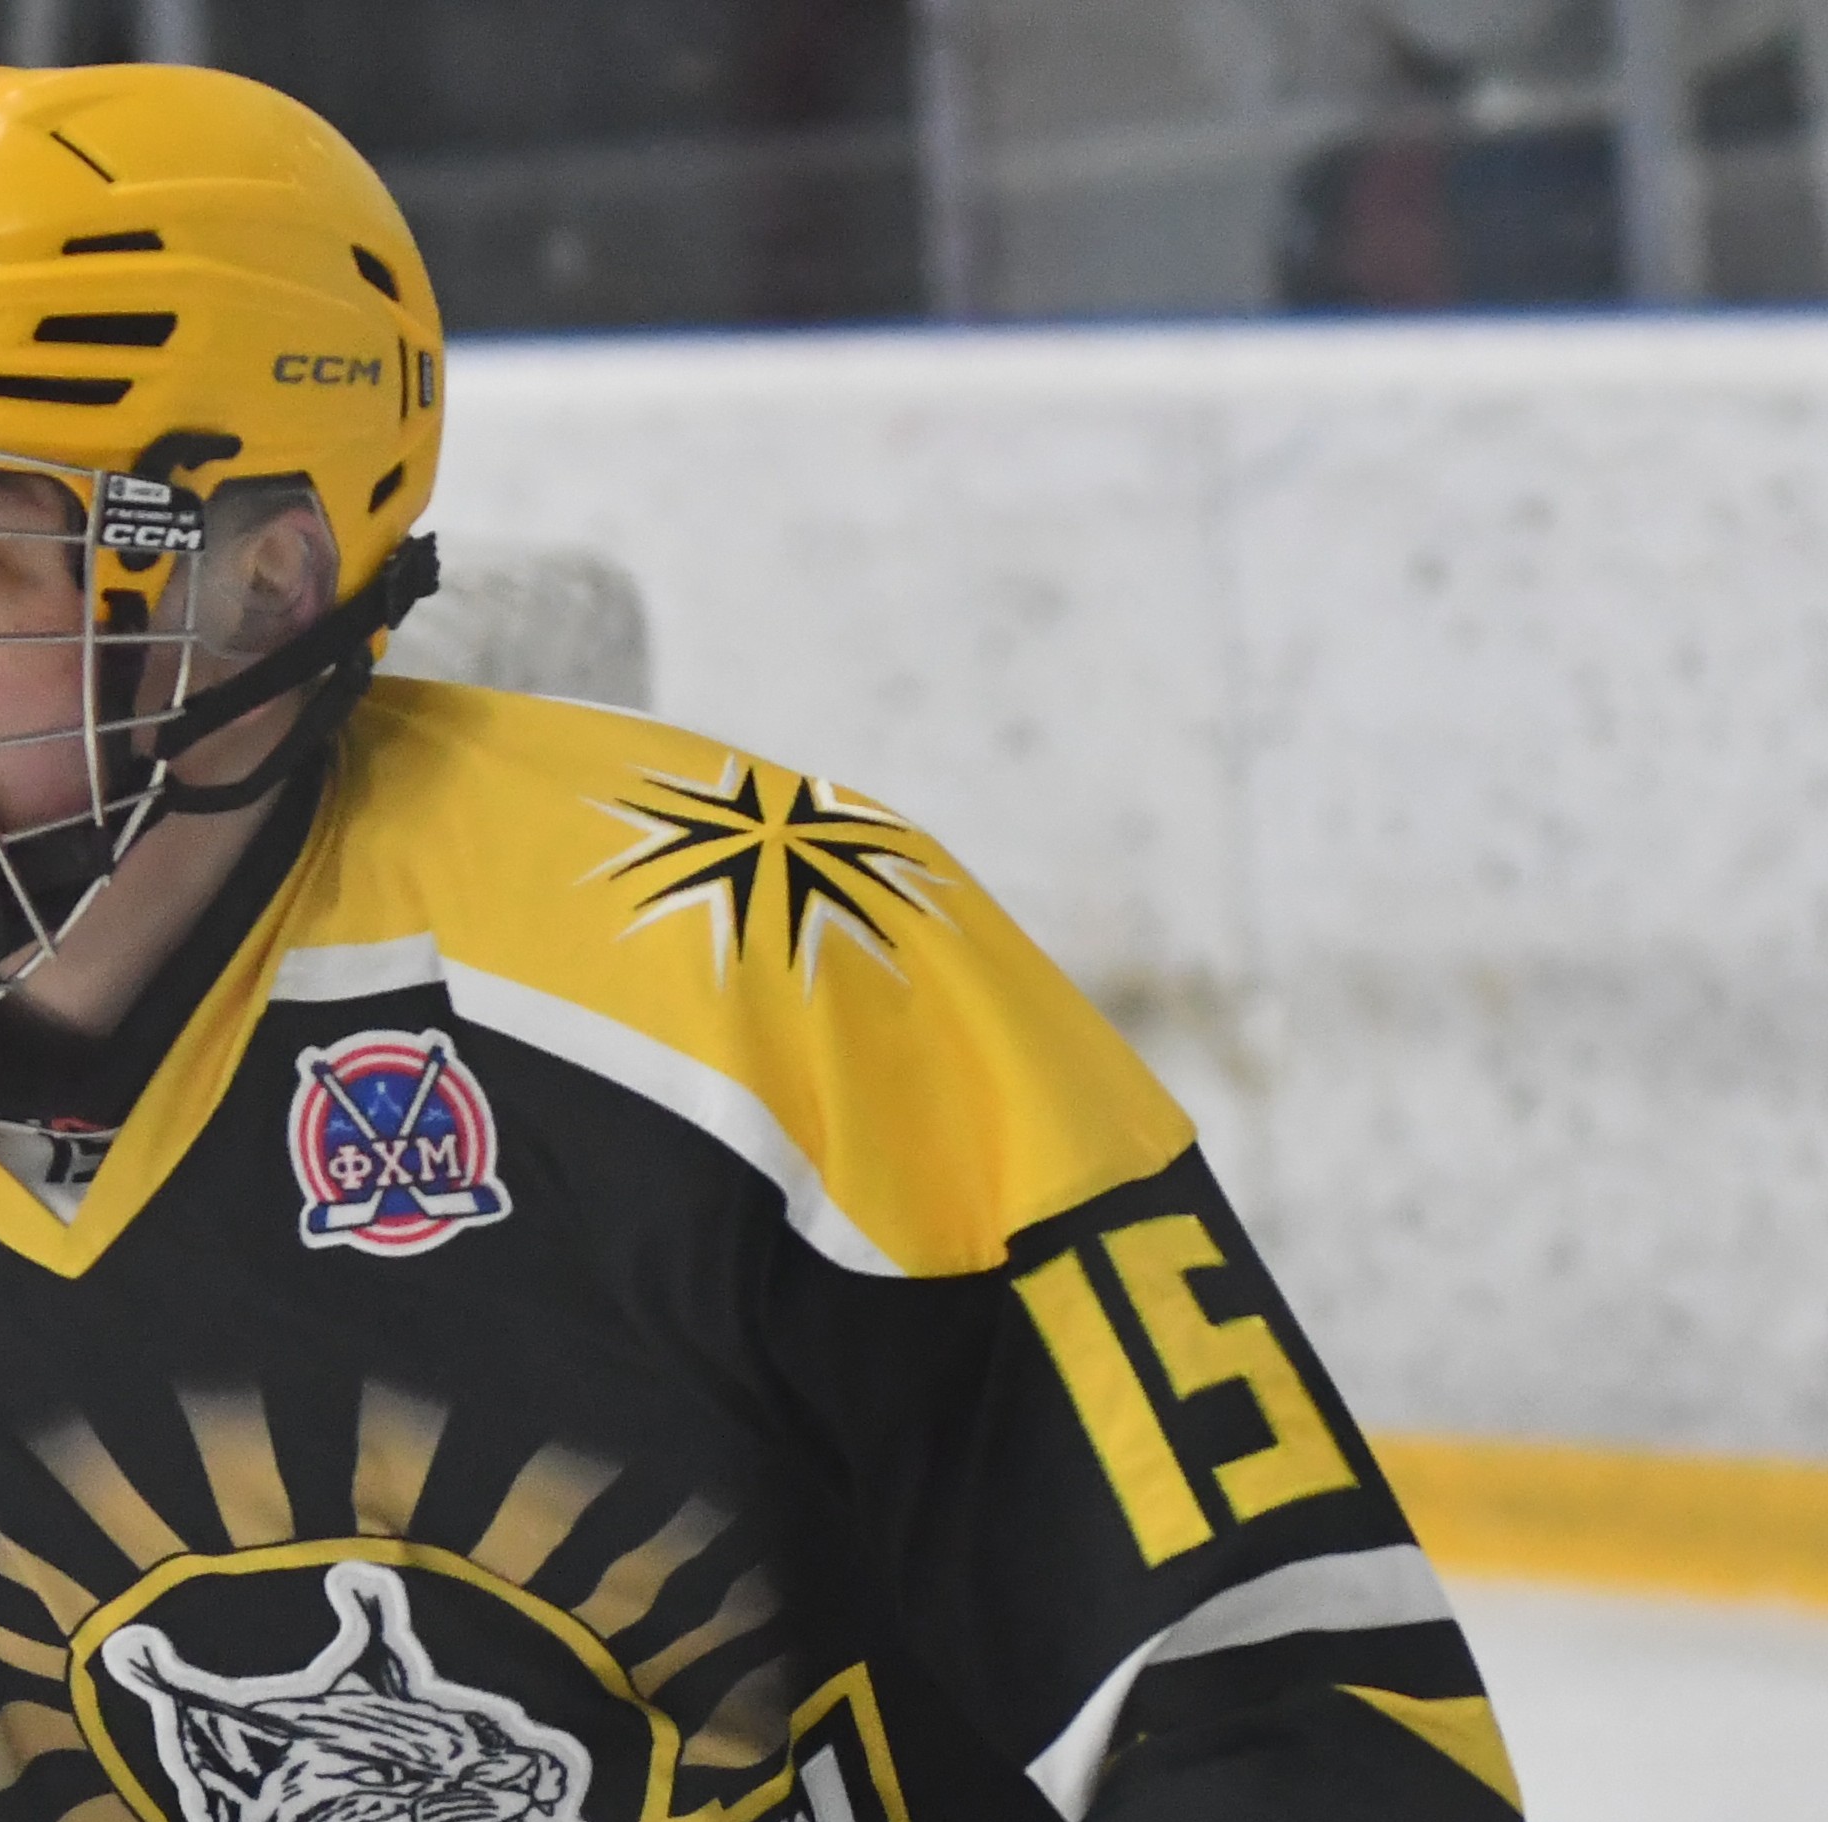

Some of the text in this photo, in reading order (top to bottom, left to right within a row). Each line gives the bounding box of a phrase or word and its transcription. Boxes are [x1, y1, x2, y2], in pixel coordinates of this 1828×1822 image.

[273, 354, 383, 385] CCM
[102, 522, 203, 550] CCM
[328, 1133, 462, 1190] ФХМ
[1010, 1212, 1361, 1570] 15
